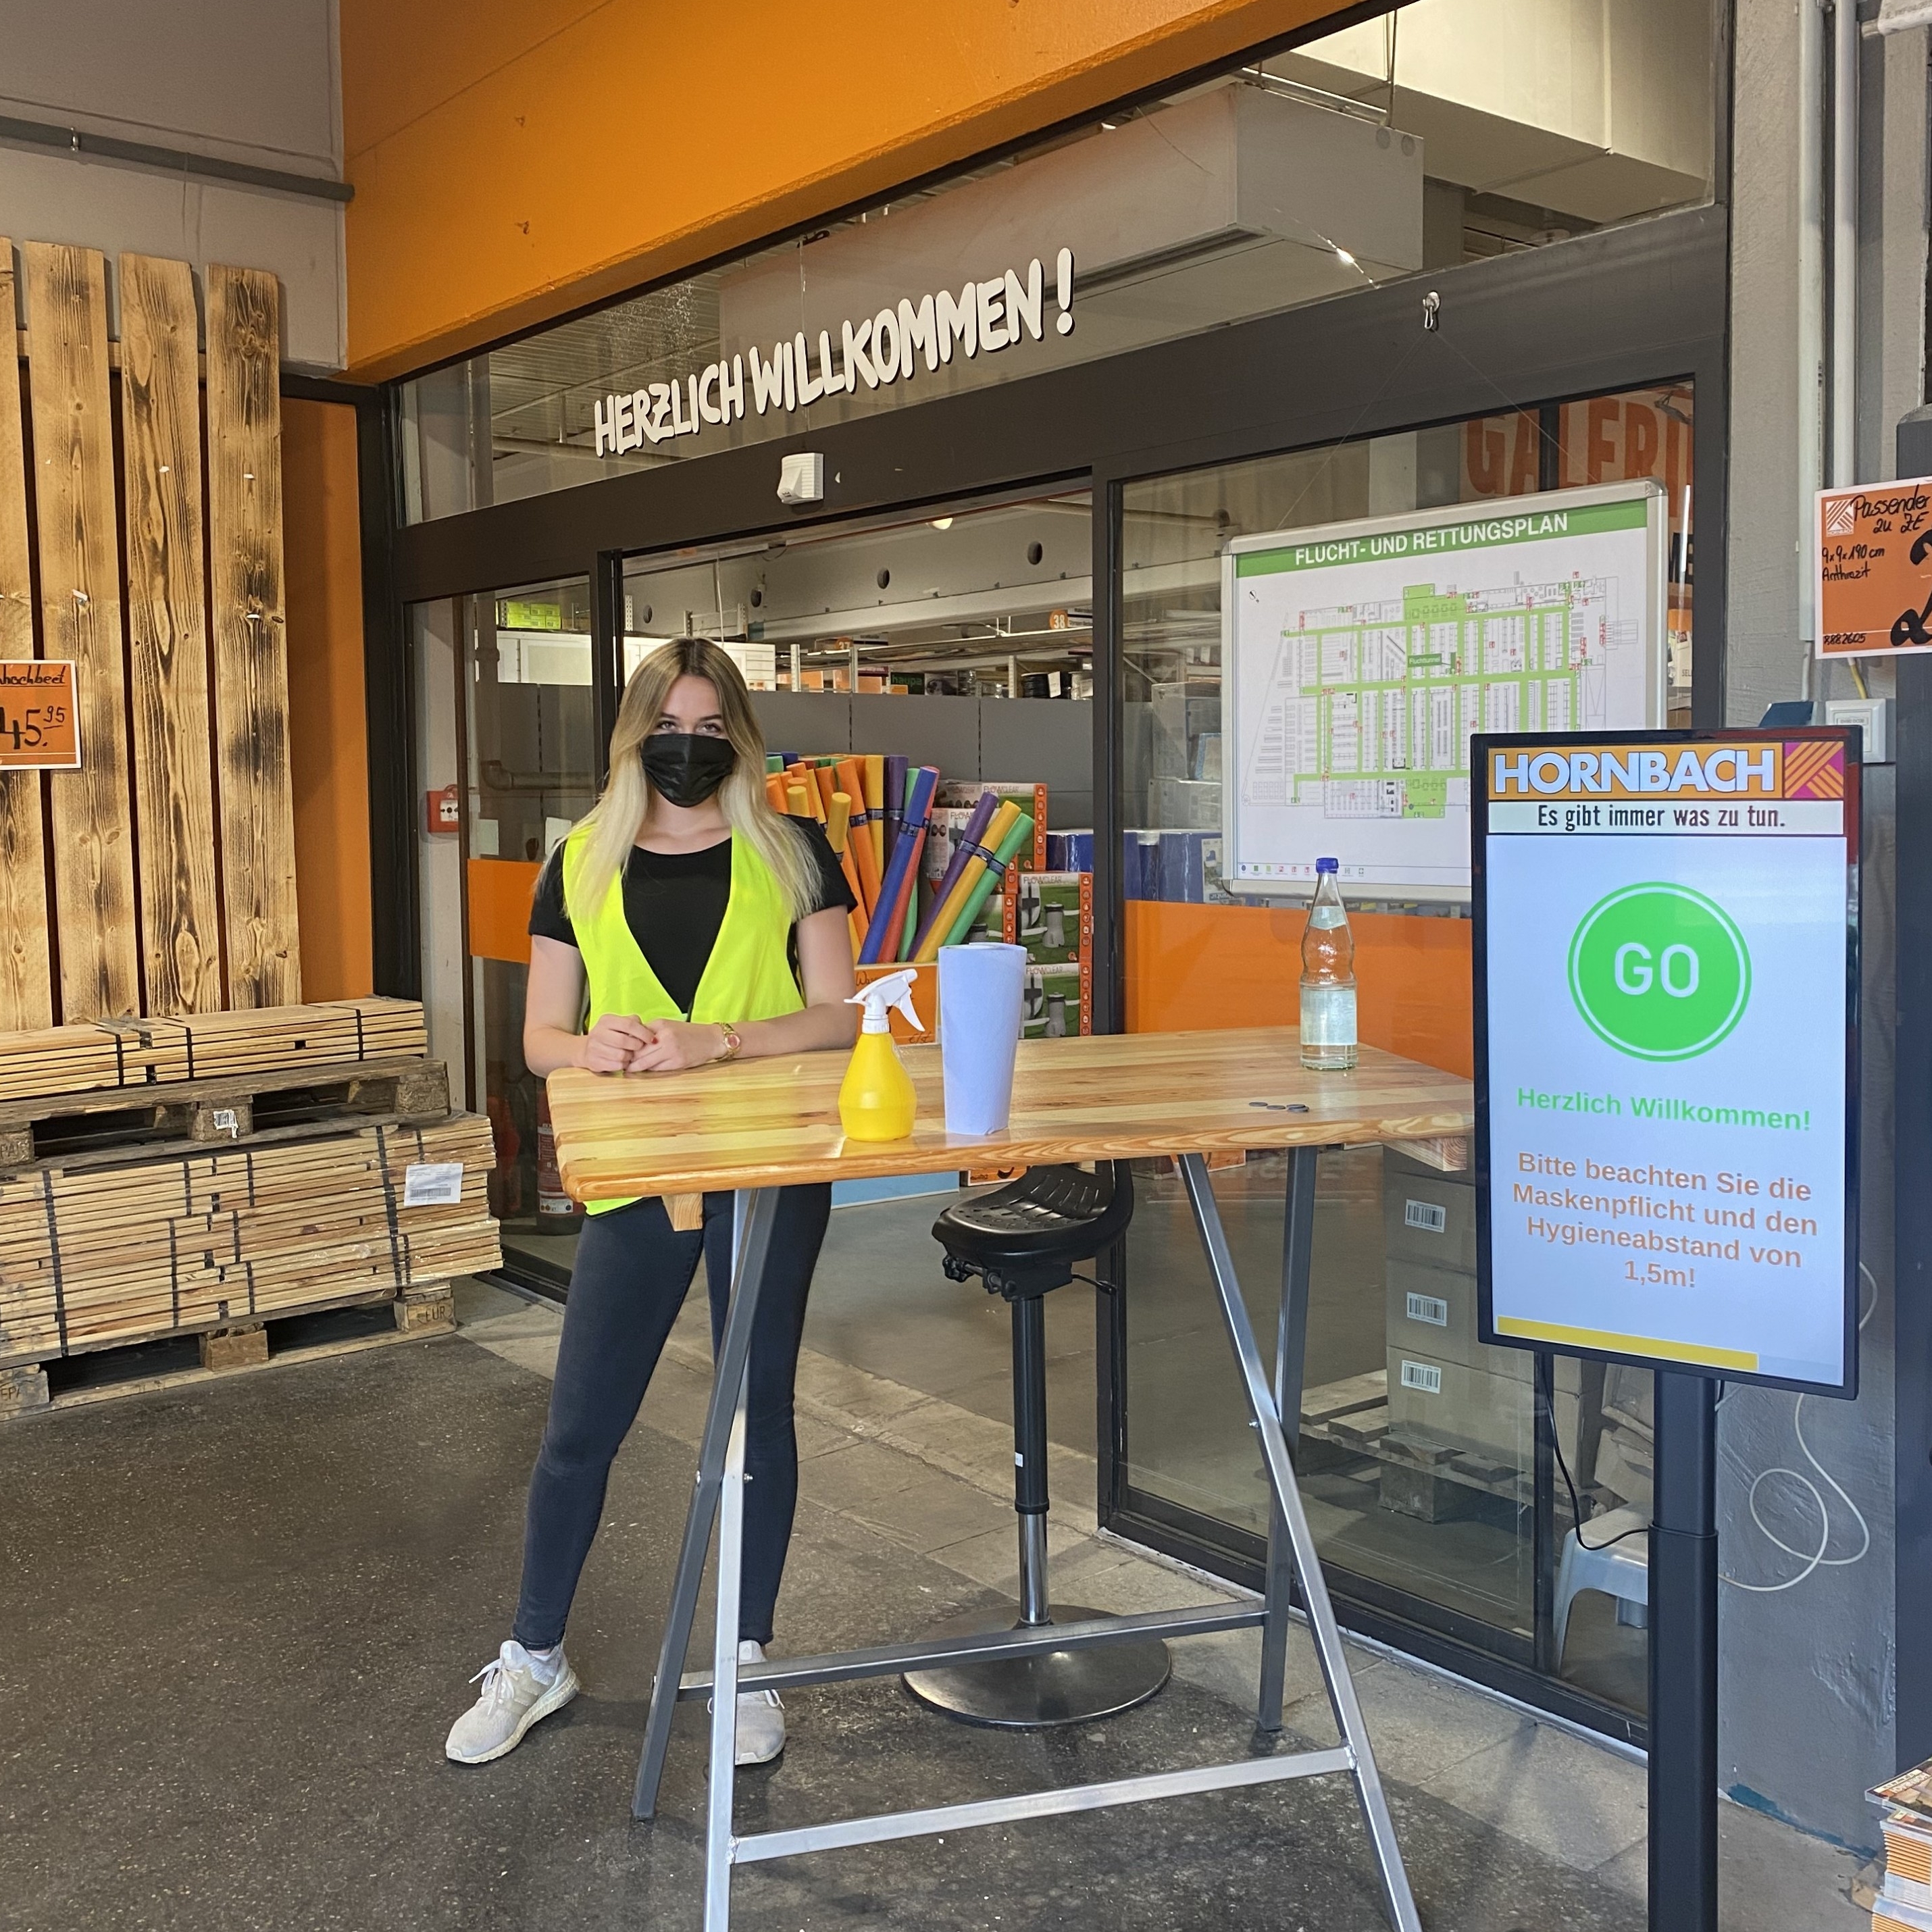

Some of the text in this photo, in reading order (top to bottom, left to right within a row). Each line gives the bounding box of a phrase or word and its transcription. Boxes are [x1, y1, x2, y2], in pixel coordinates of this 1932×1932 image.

[594, 353, 744, 457] HERZLICH
[1295, 513, 1569, 566] FLUCHT- UND RETTUNGSPLAN
[1053, 614, 1066, 629] 38
[1494, 748, 1775, 794] HORNBACH
[1537, 805, 1786, 832] Es gibt immer was zu tun.
[1615, 942, 1700, 999] GO
[1517, 1088, 1811, 1132] Herzlich Willkommen!
[1518, 1152, 1812, 1201] Bitte beachten Sie die
[1512, 1184, 1818, 1236] Maskenpflicht und den
[1527, 1216, 1802, 1268] Hygieneabstand von
[1624, 1261, 1696, 1288] 1,5m!
